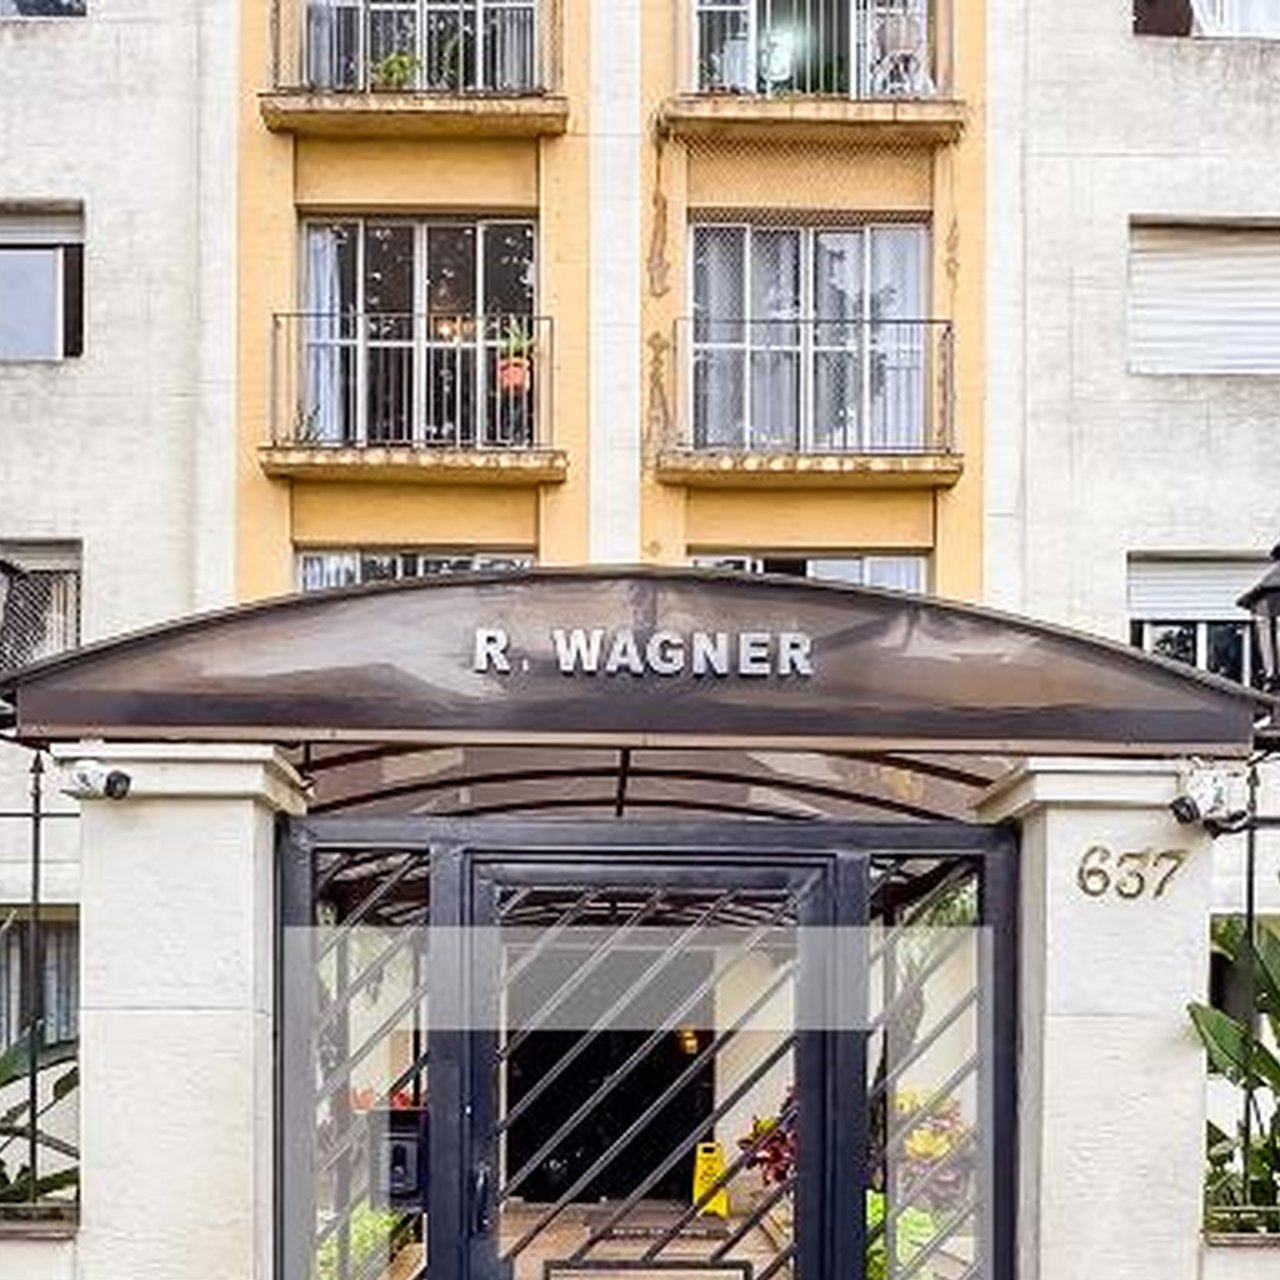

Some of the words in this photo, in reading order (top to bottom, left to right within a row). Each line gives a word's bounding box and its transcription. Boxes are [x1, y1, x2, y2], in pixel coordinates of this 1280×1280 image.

[473, 627, 530, 674] R.
[552, 628, 814, 676] WAGNER
[1077, 846, 1189, 899] 637
